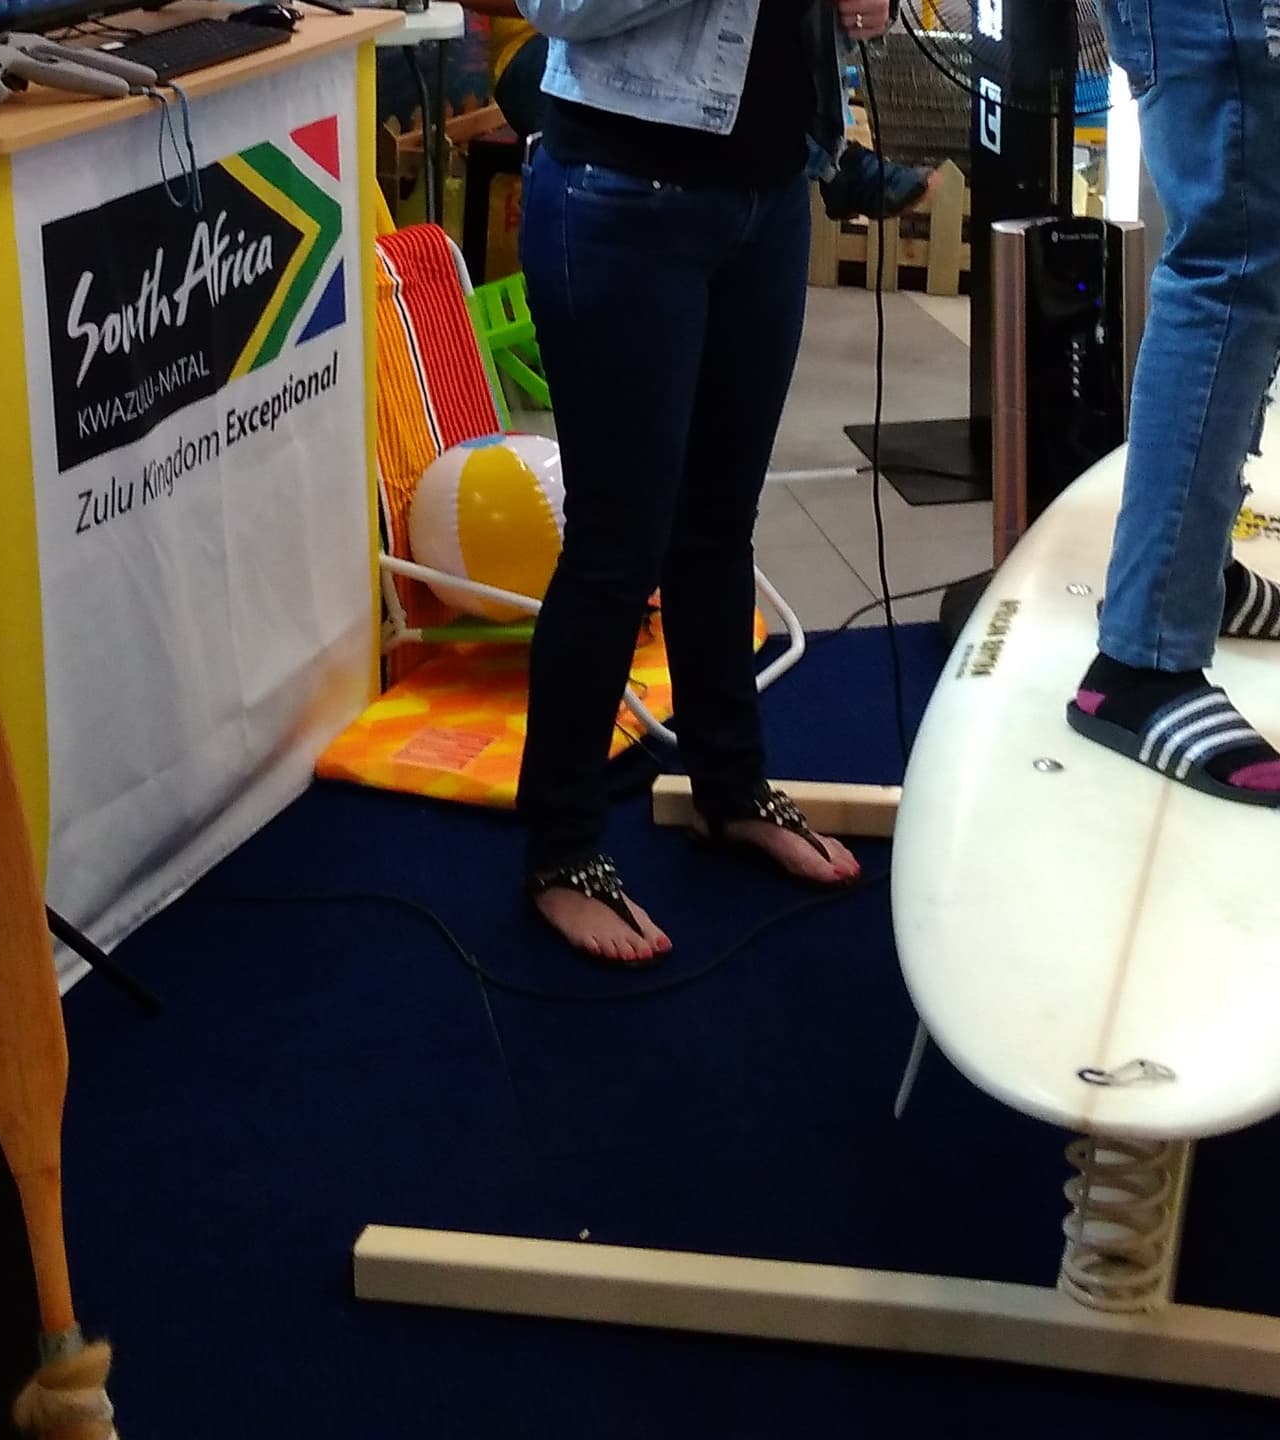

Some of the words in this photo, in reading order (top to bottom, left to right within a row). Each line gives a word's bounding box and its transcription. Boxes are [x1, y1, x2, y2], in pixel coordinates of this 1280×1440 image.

[67, 246, 172, 389] South
[173, 209, 273, 328] Africa
[76, 475, 134, 535] Zulu
[142, 429, 220, 506] Kingdom
[226, 350, 340, 448] Exceptional
[77, 350, 211, 439] KWAZULU-NATAL
